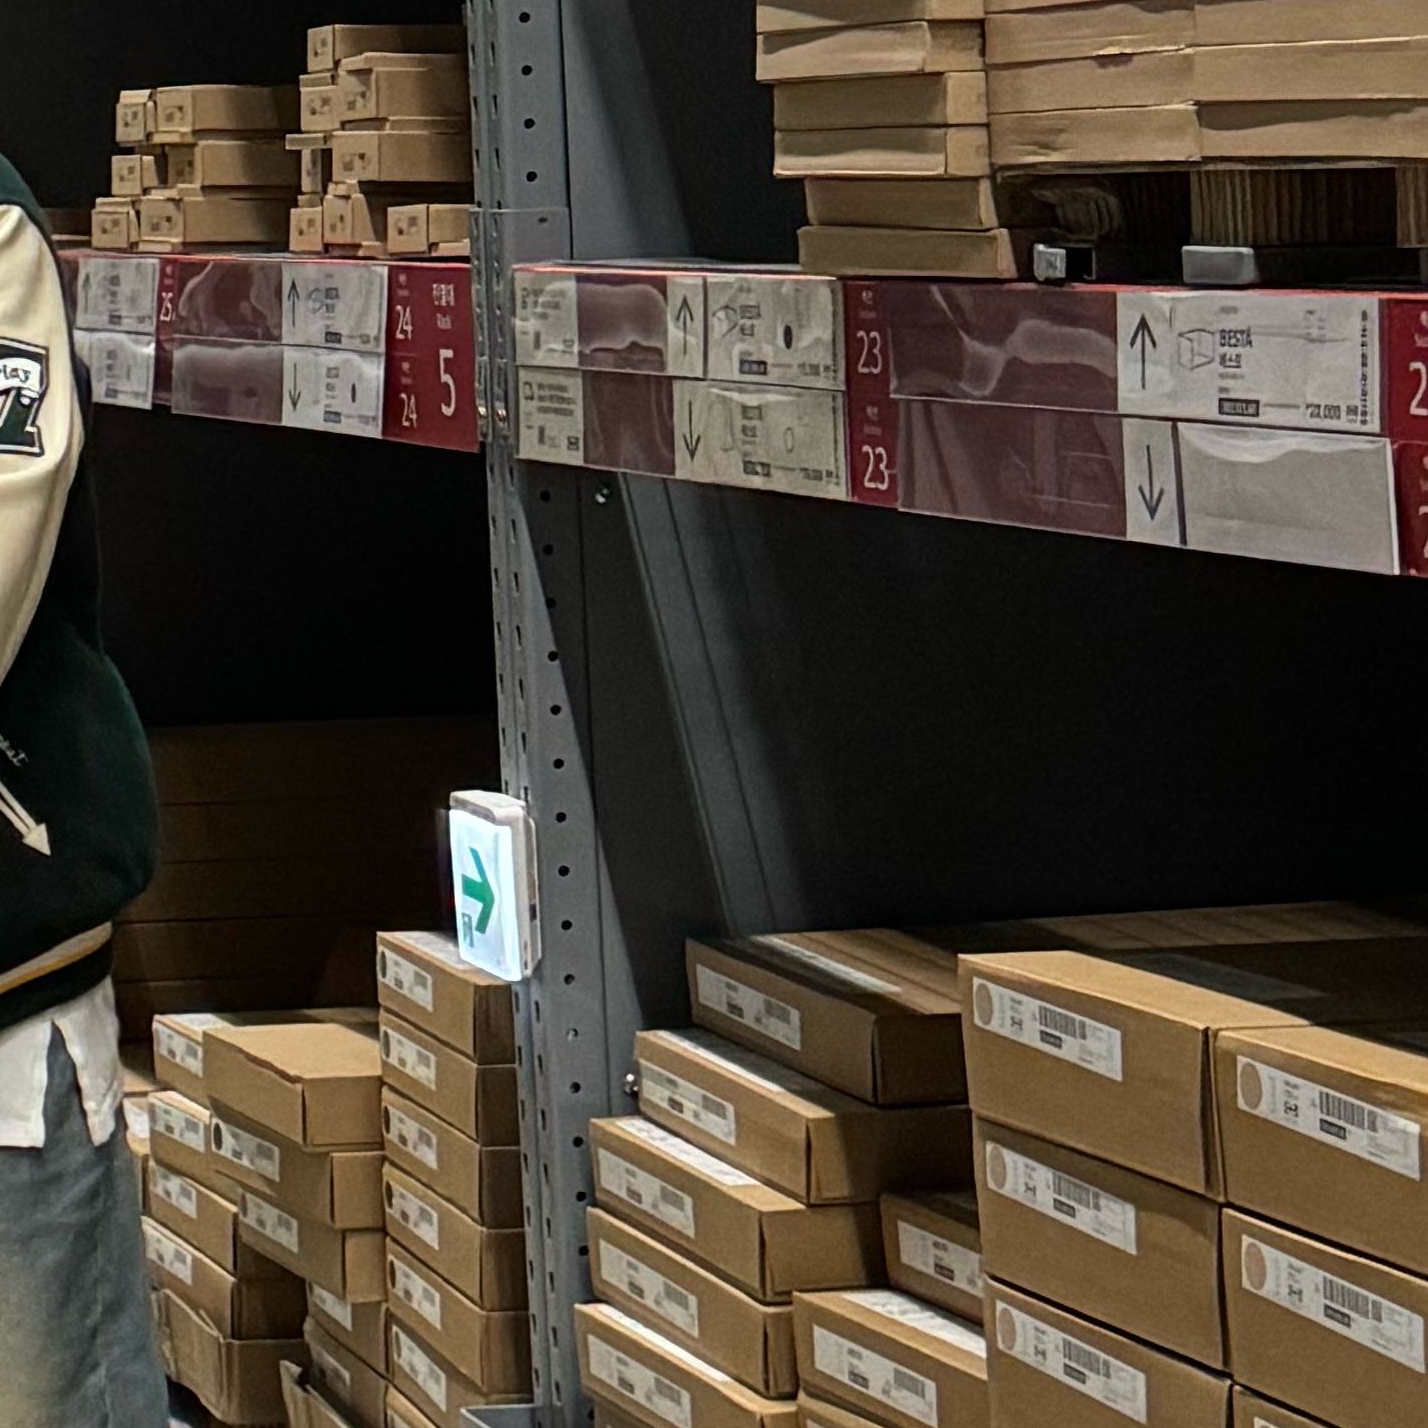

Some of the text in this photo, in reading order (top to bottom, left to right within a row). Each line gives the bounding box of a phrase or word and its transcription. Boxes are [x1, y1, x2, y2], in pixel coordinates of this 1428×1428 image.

[396, 305, 413, 340] 24
[857, 330, 882, 375] 23
[438, 348, 457, 417] 5
[400, 392, 418, 429] 24
[863, 444, 888, 492] 23
